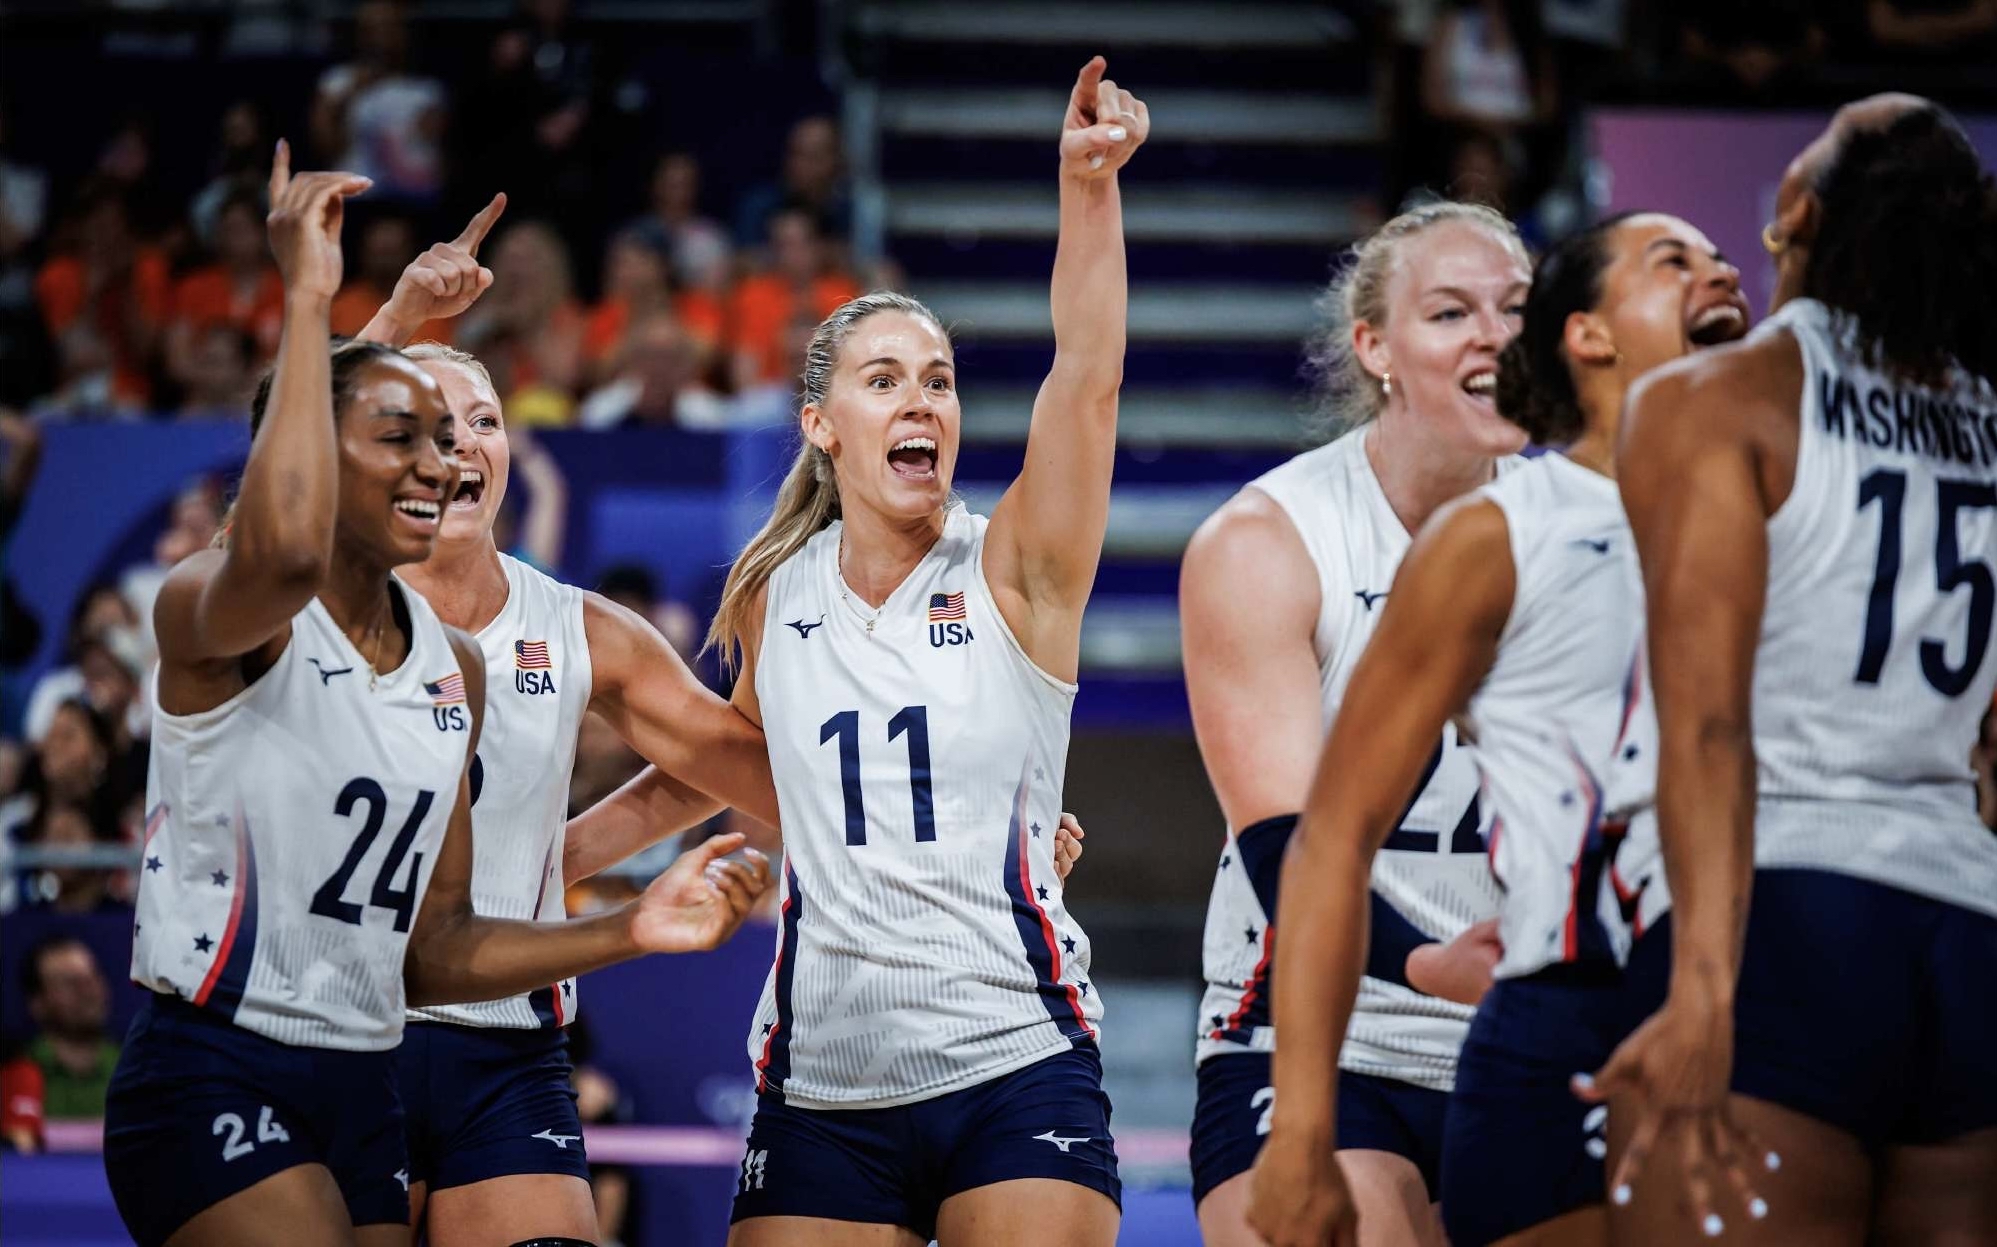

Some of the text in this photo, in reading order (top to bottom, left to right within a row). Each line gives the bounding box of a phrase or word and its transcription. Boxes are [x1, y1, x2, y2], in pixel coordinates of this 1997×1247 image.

[1854, 467, 1996, 697] 15
[928, 623, 974, 648] USA
[515, 669, 556, 695] USA
[433, 706, 467, 731] US
[819, 705, 936, 846] 11
[308, 777, 435, 933] 24
[212, 1105, 290, 1162] 24
